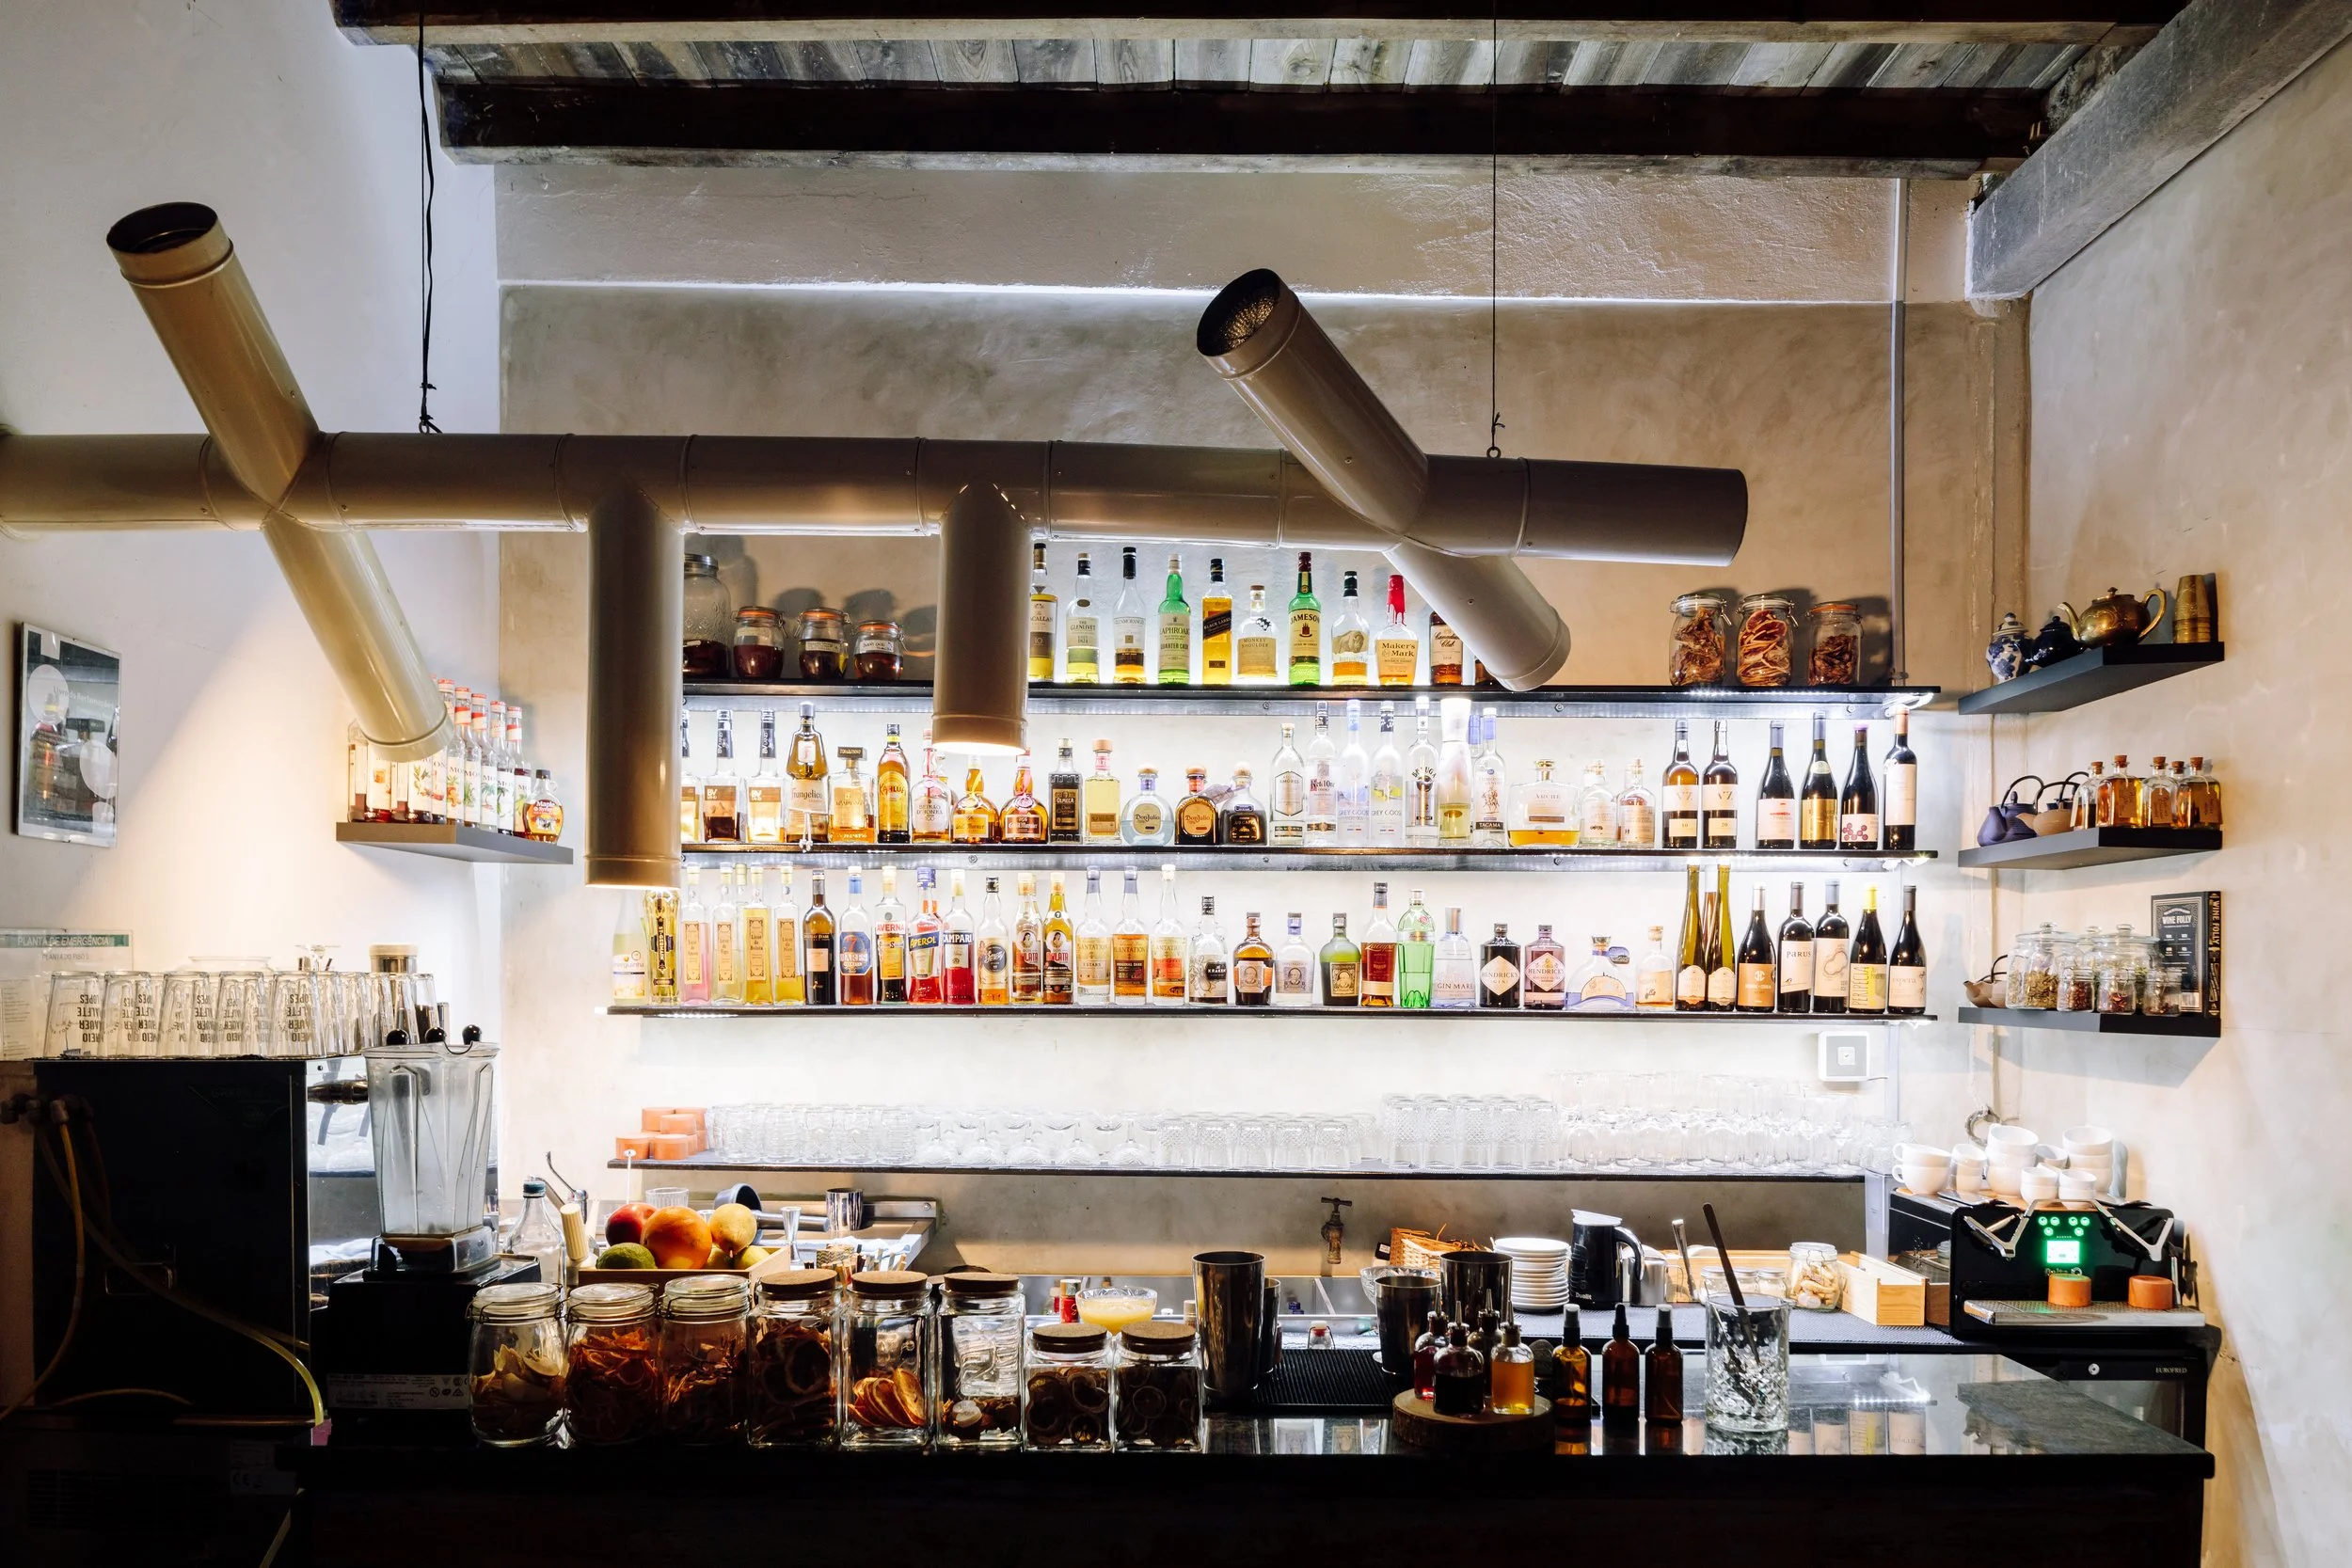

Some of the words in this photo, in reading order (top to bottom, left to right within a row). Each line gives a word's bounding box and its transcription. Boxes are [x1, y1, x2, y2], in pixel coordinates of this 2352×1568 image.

[1290, 613, 1320, 625] JAMESON
[1411, 767, 1437, 778] BEUGA
[2212, 900, 2220, 921] WINE
[2162, 915, 2175, 925] WINE
[2176, 914, 2192, 924] FOLLY
[943, 934, 973, 943] CAMPARI
[2212, 922, 2220, 944] FOLLY
[18, 936, 47, 946] PLANTA
[61, 934, 109, 946] EMERGÊNCIA
[910, 937, 936, 948] APEROL
